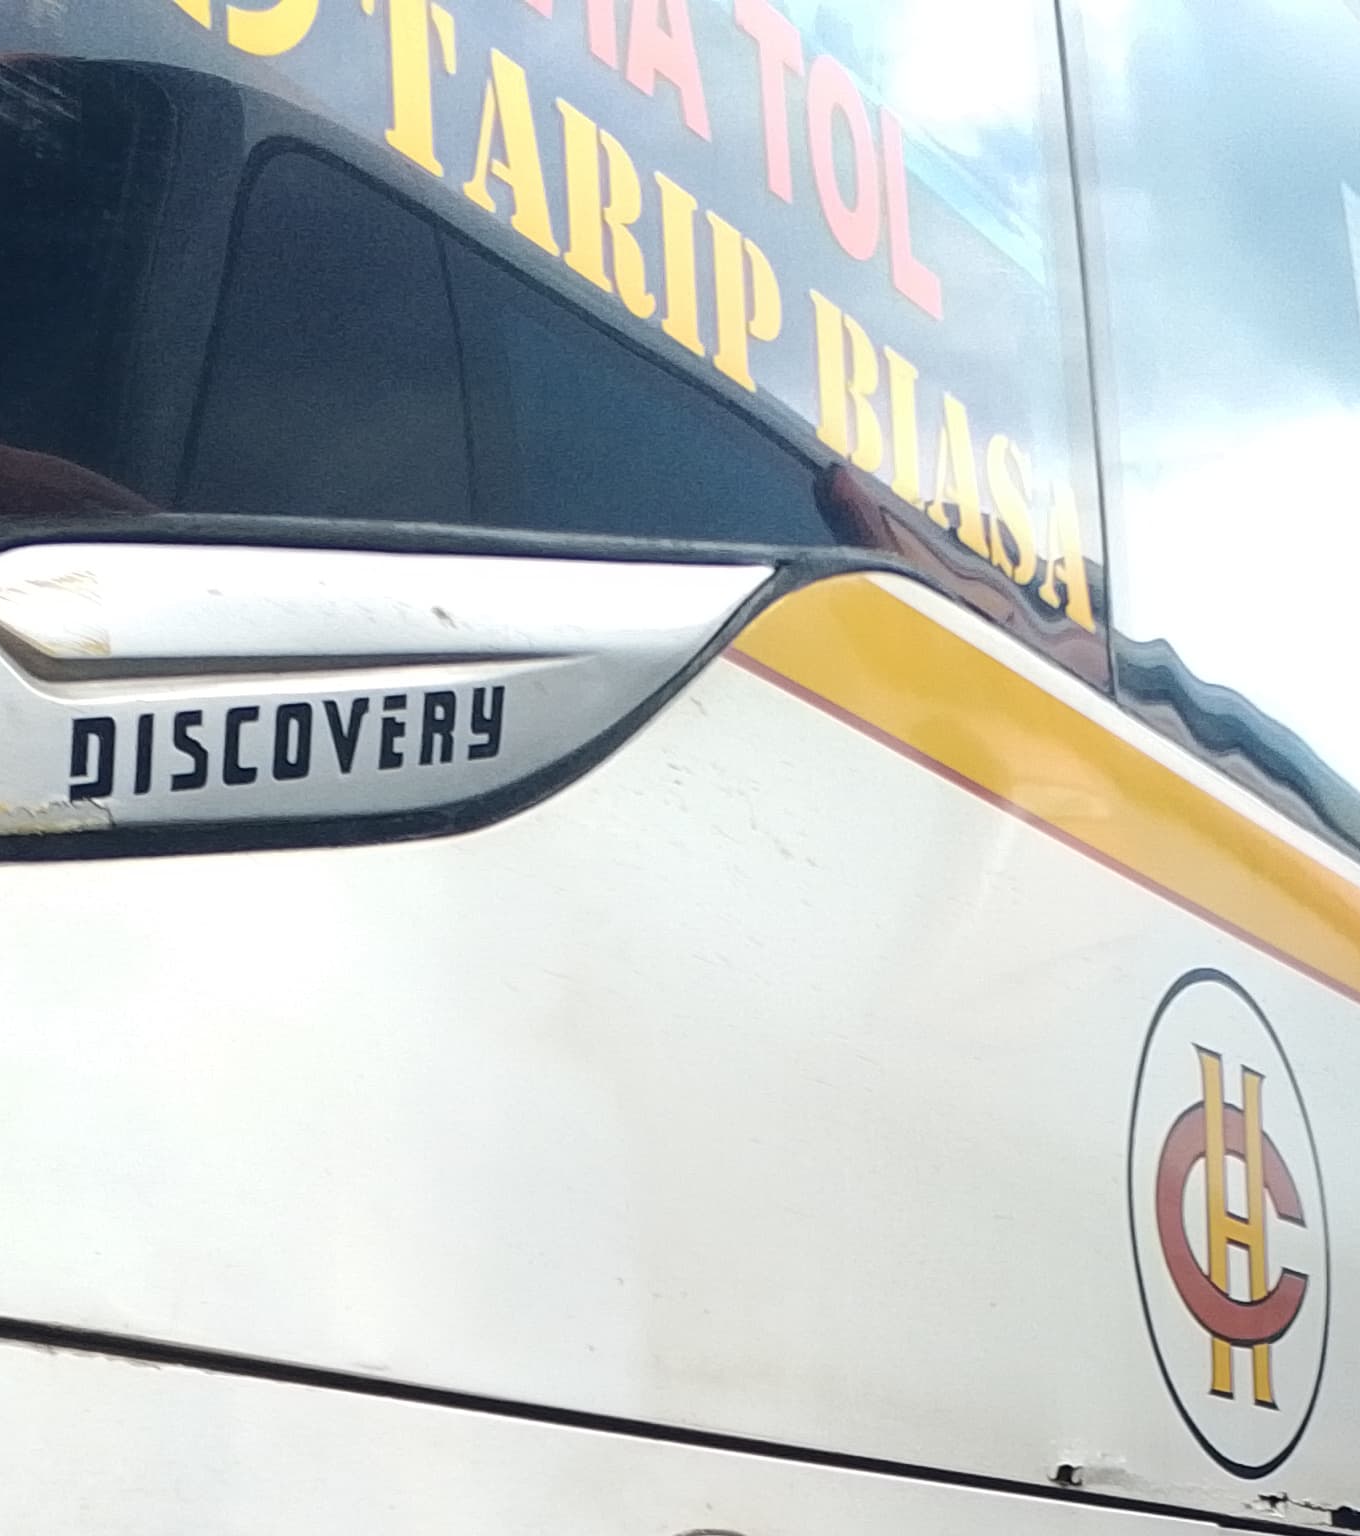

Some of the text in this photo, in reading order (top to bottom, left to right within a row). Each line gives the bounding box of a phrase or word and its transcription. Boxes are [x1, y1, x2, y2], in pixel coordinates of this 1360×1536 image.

[360, 0, 1096, 633] TARIP BIASA
[735, 0, 943, 320] TOL
[69, 686, 506, 802] DISCOVERY
